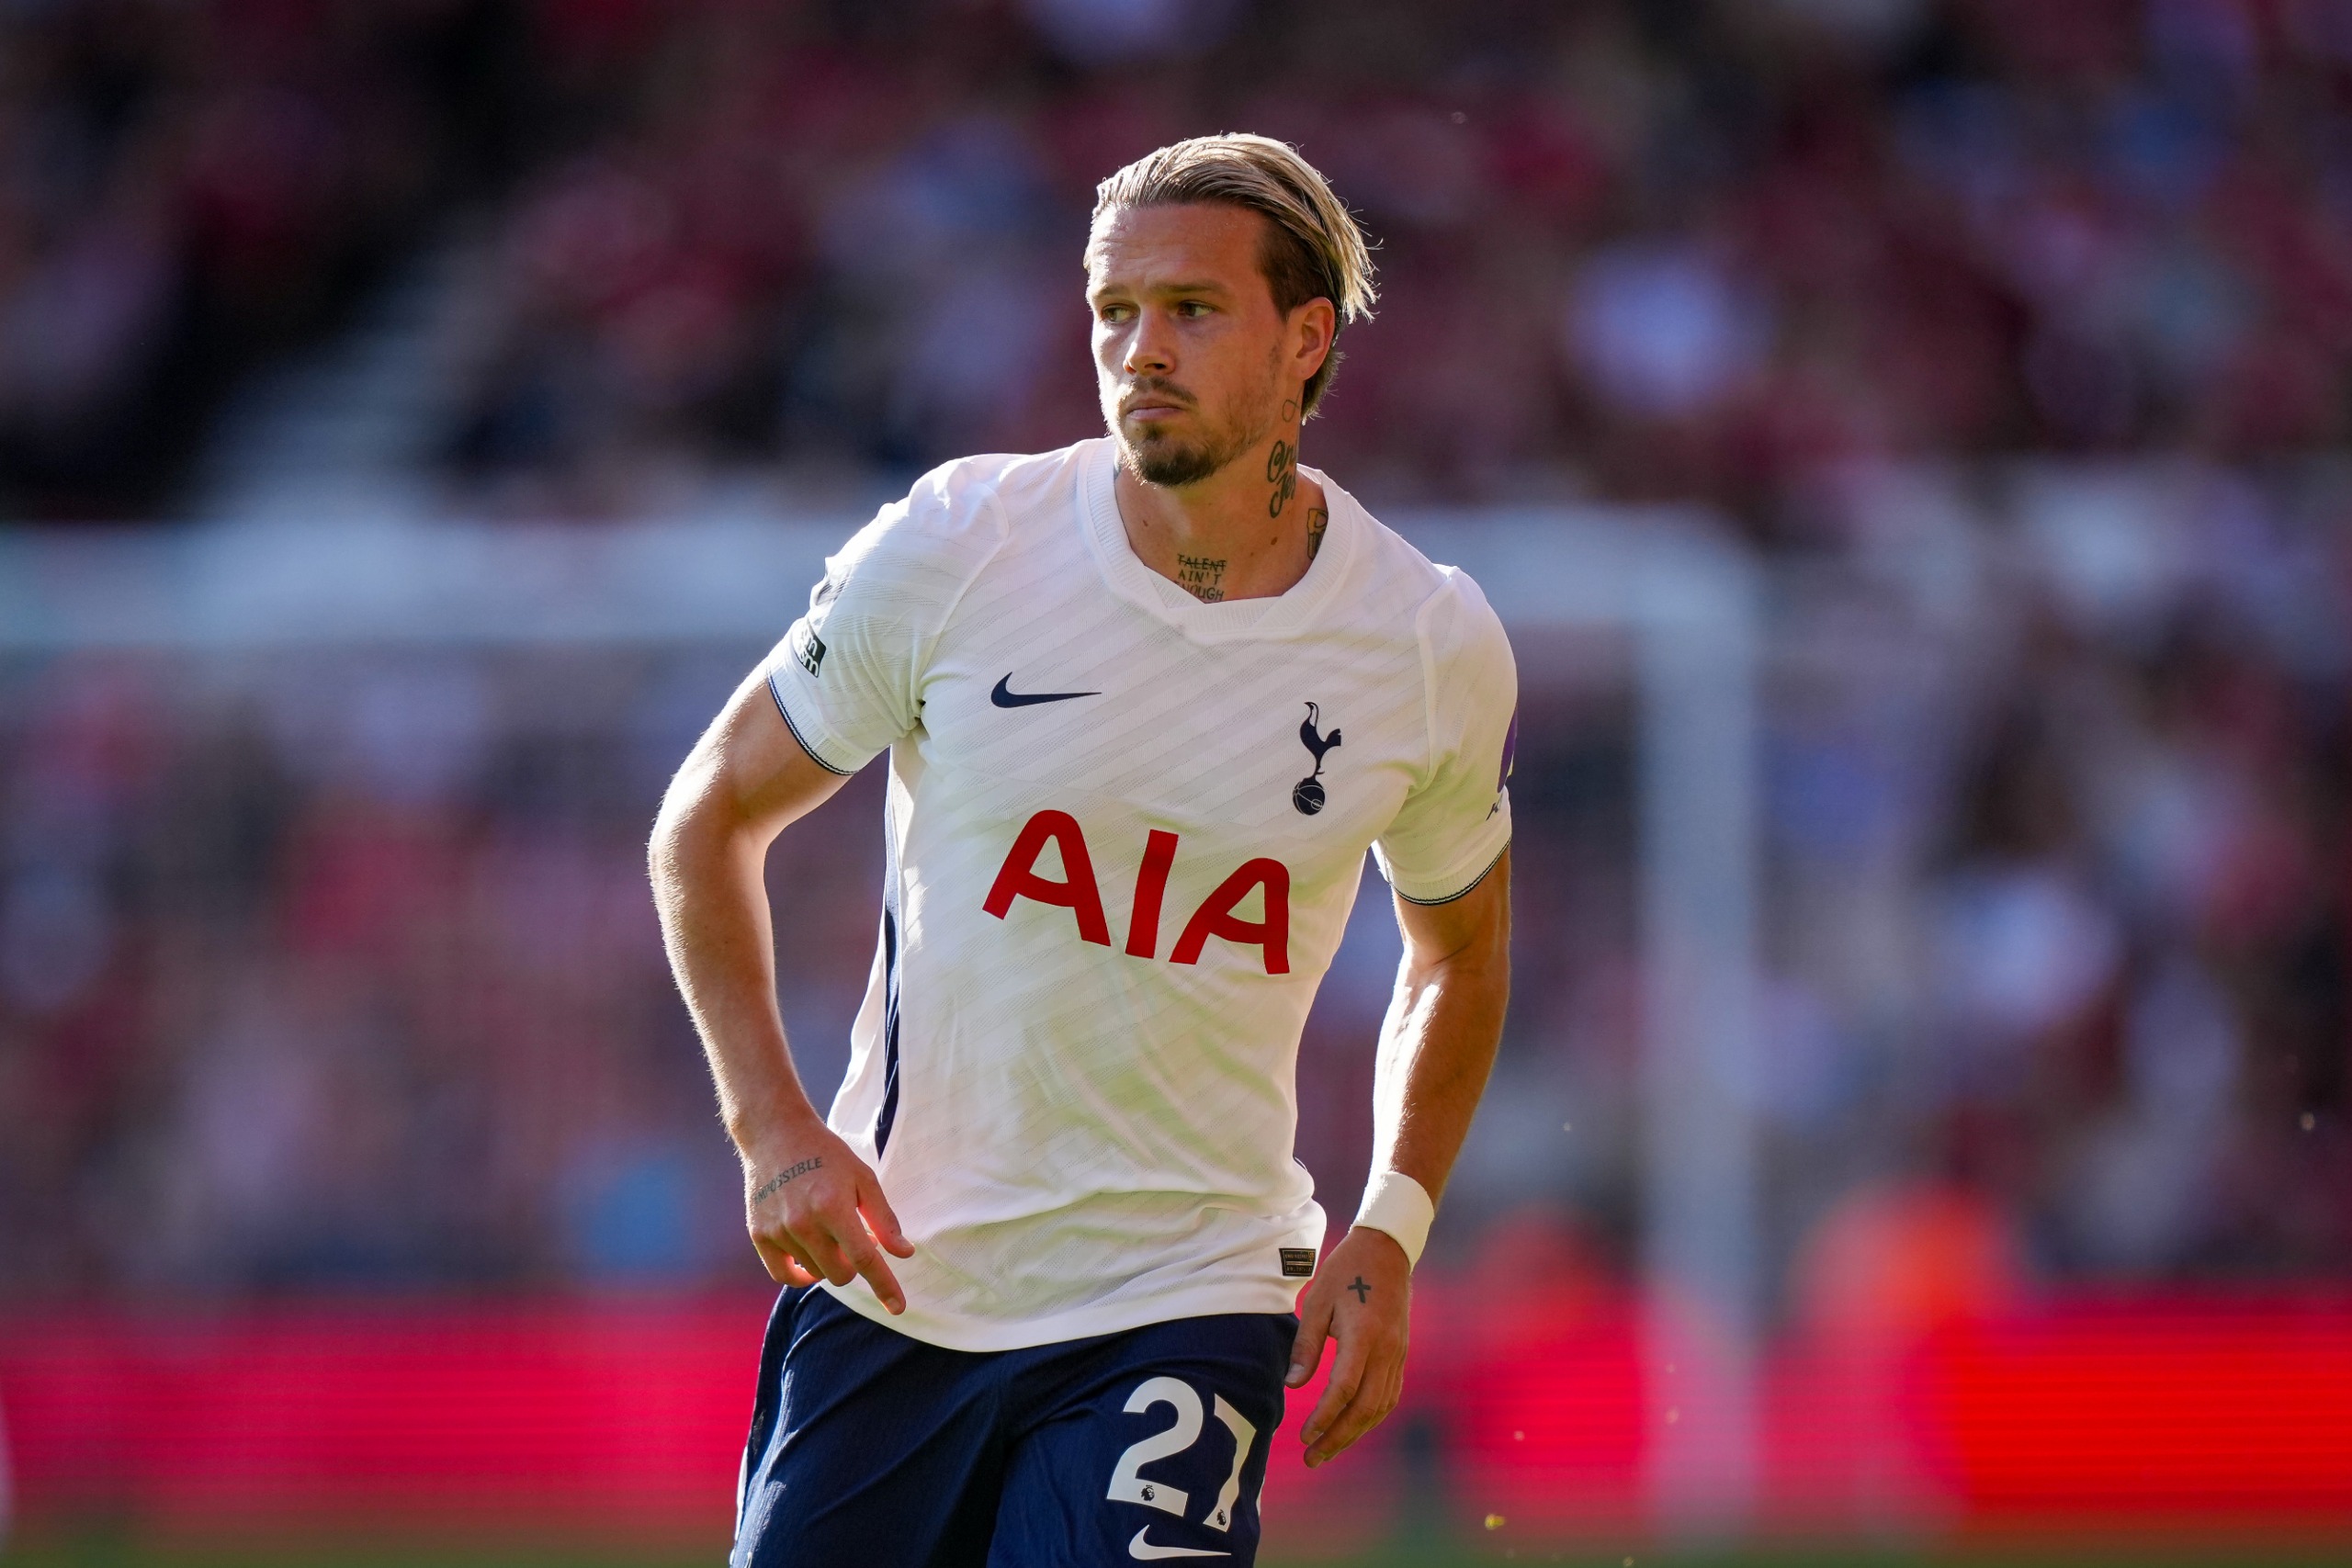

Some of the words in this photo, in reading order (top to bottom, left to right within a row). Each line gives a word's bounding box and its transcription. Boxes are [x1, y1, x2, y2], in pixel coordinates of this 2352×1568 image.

[1177, 554, 1227, 572] TALENT
[1178, 570, 1223, 585] AIN'T
[982, 809, 1290, 975] AIA
[1106, 1376, 1257, 1532] 27
